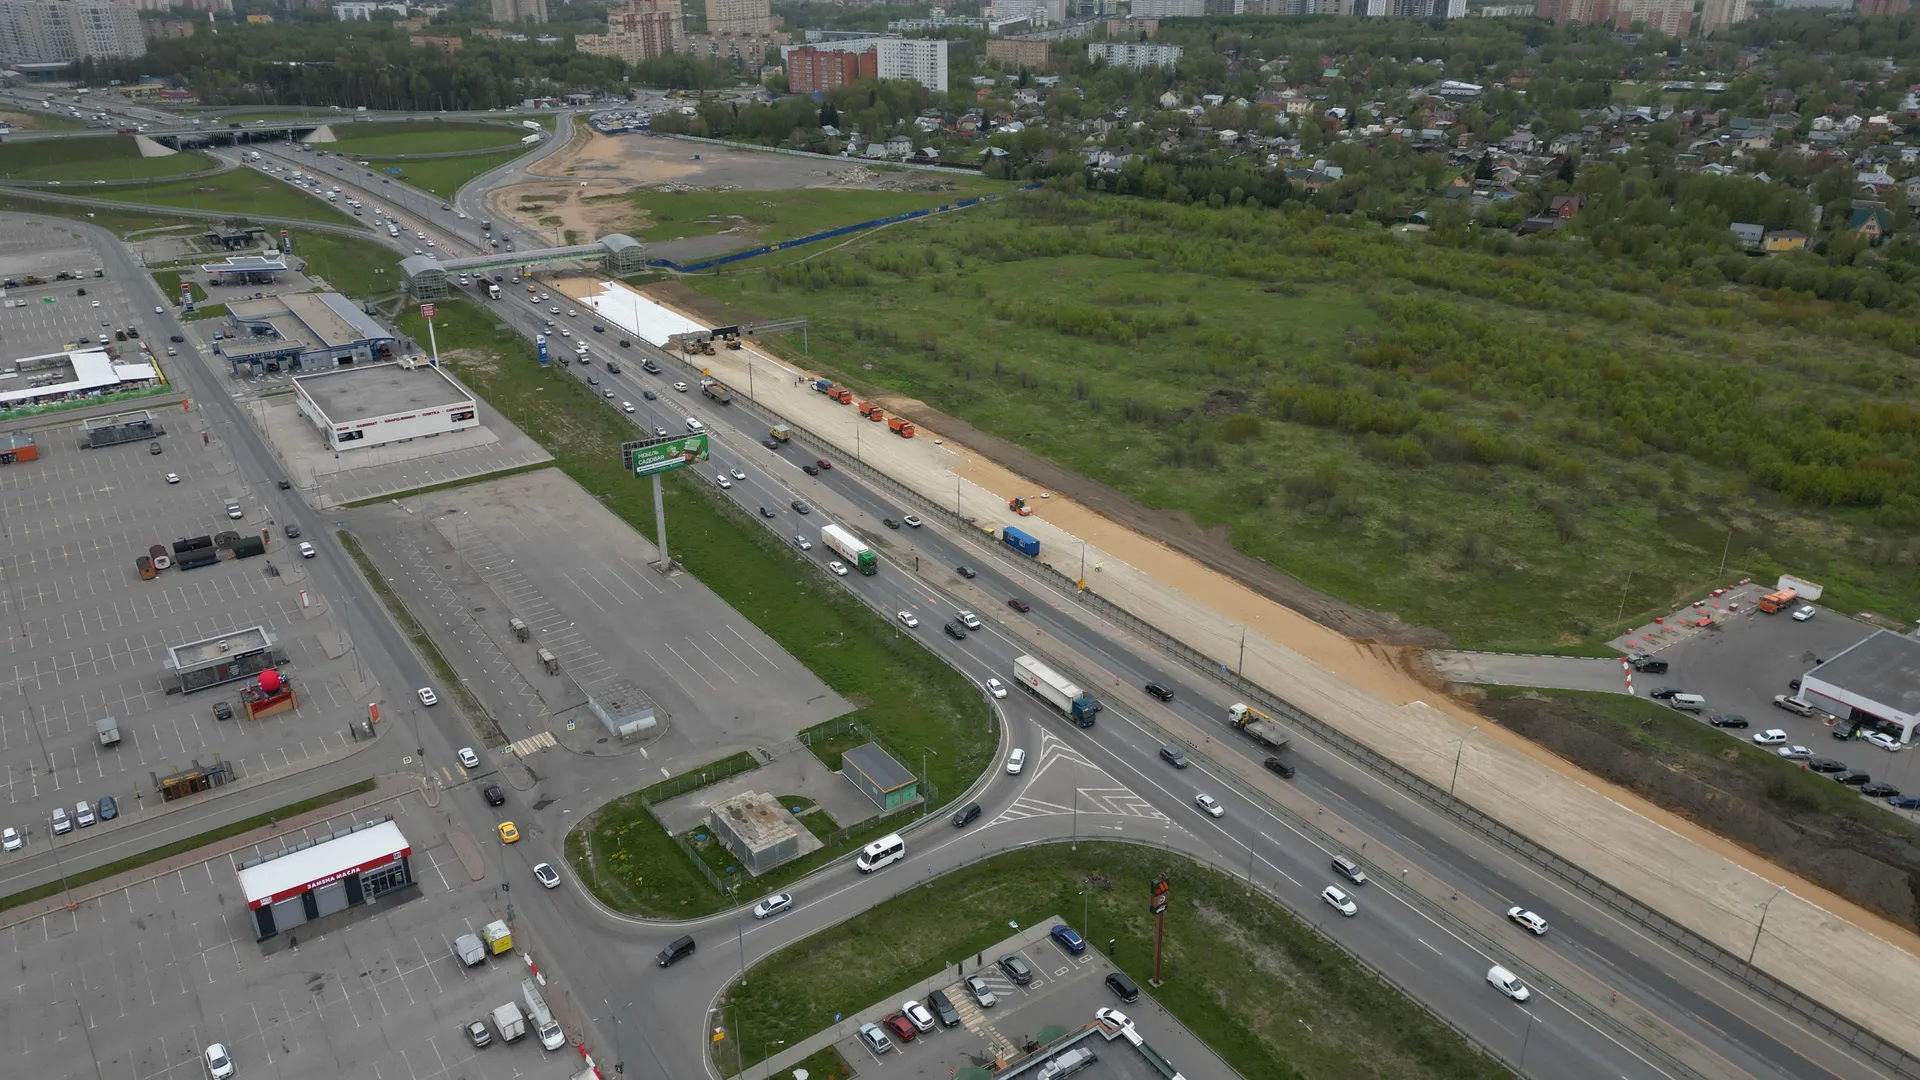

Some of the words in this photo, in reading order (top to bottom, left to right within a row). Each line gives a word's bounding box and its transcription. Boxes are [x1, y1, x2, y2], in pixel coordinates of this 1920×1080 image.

[637, 450, 659, 459] МЕБЕЛЬ
[638, 455, 664, 465] САДОВАЯ
[307, 876, 335, 889] ЗАМЕНА
[336, 867, 361, 879] МАСЛА
